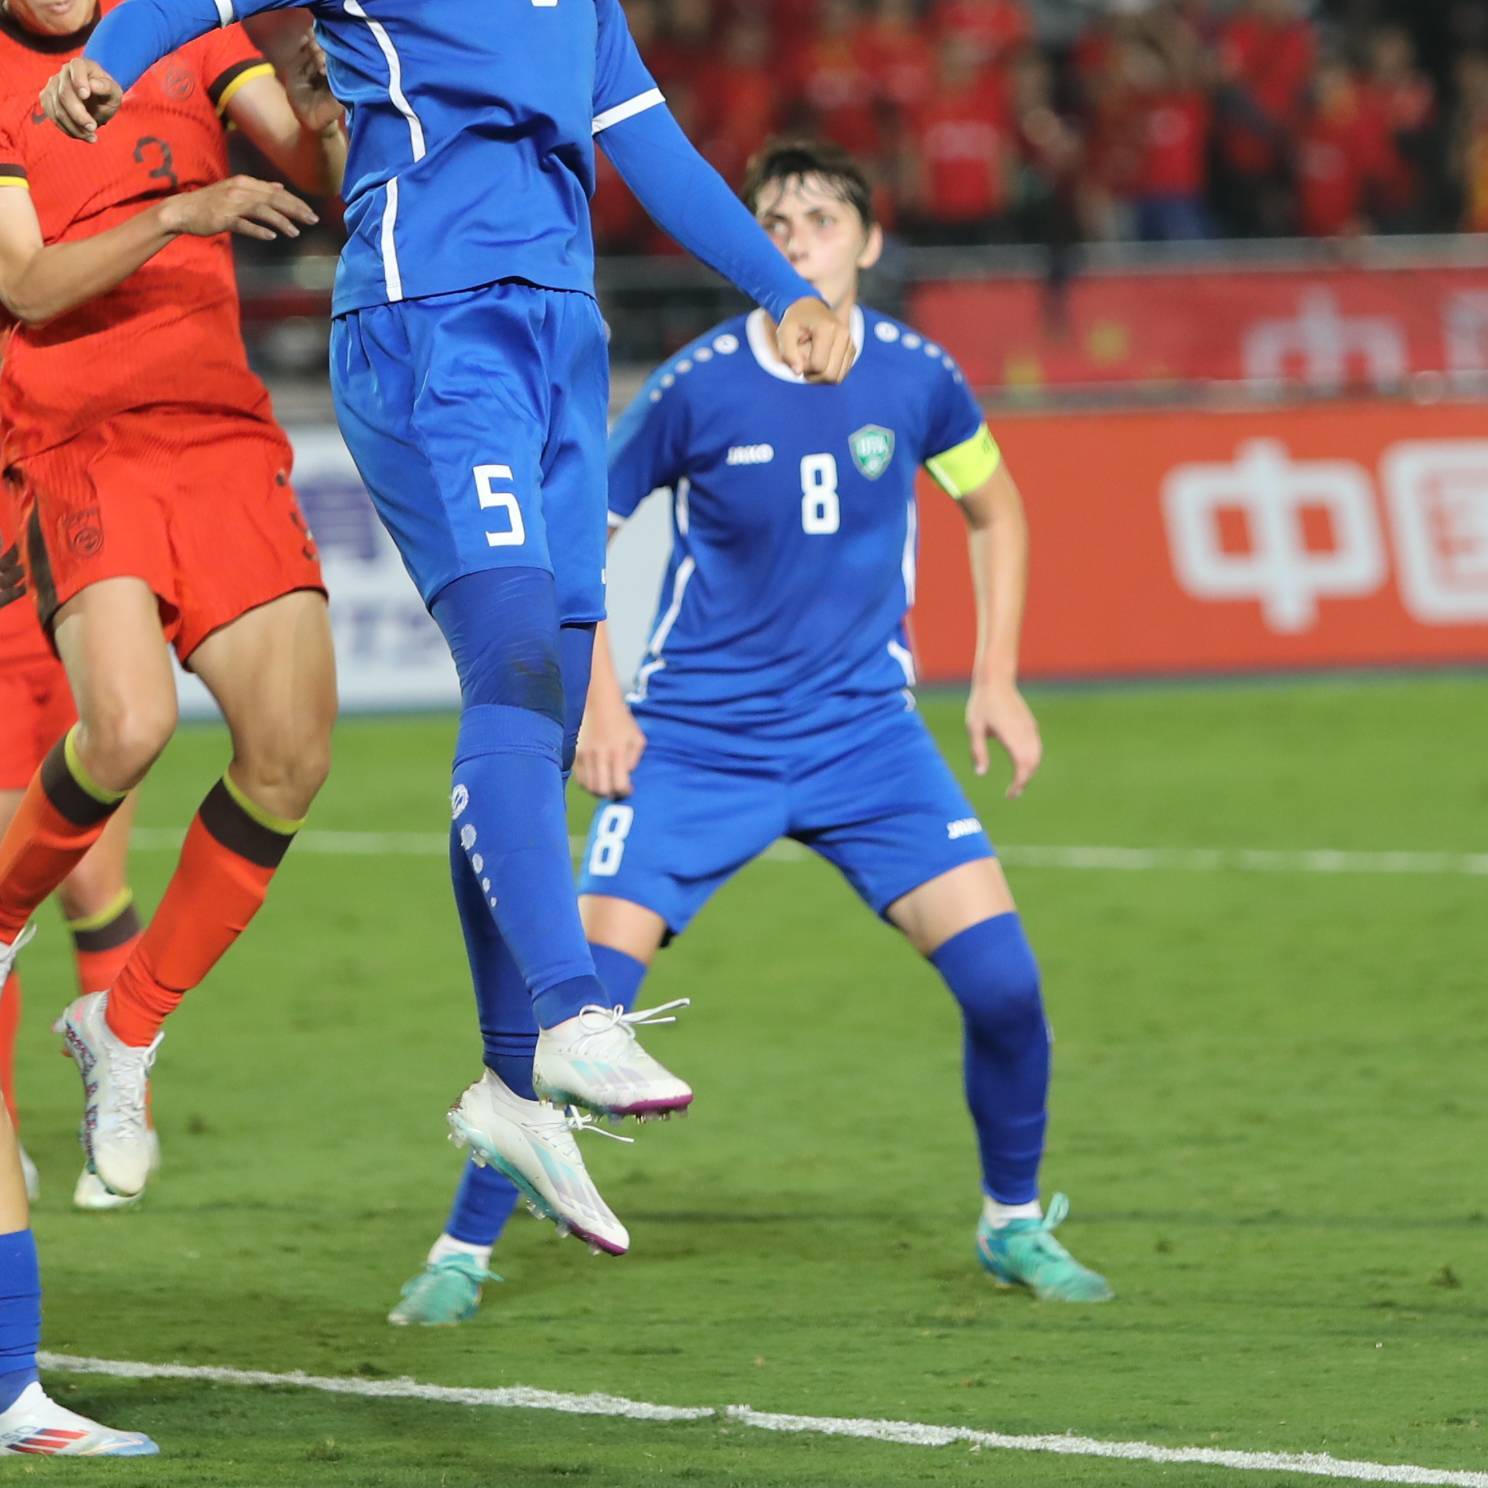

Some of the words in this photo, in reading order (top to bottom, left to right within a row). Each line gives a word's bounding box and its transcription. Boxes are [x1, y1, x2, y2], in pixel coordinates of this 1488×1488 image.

[472, 464, 526, 547] 5
[800, 452, 840, 535] 8
[589, 804, 634, 877] 8
